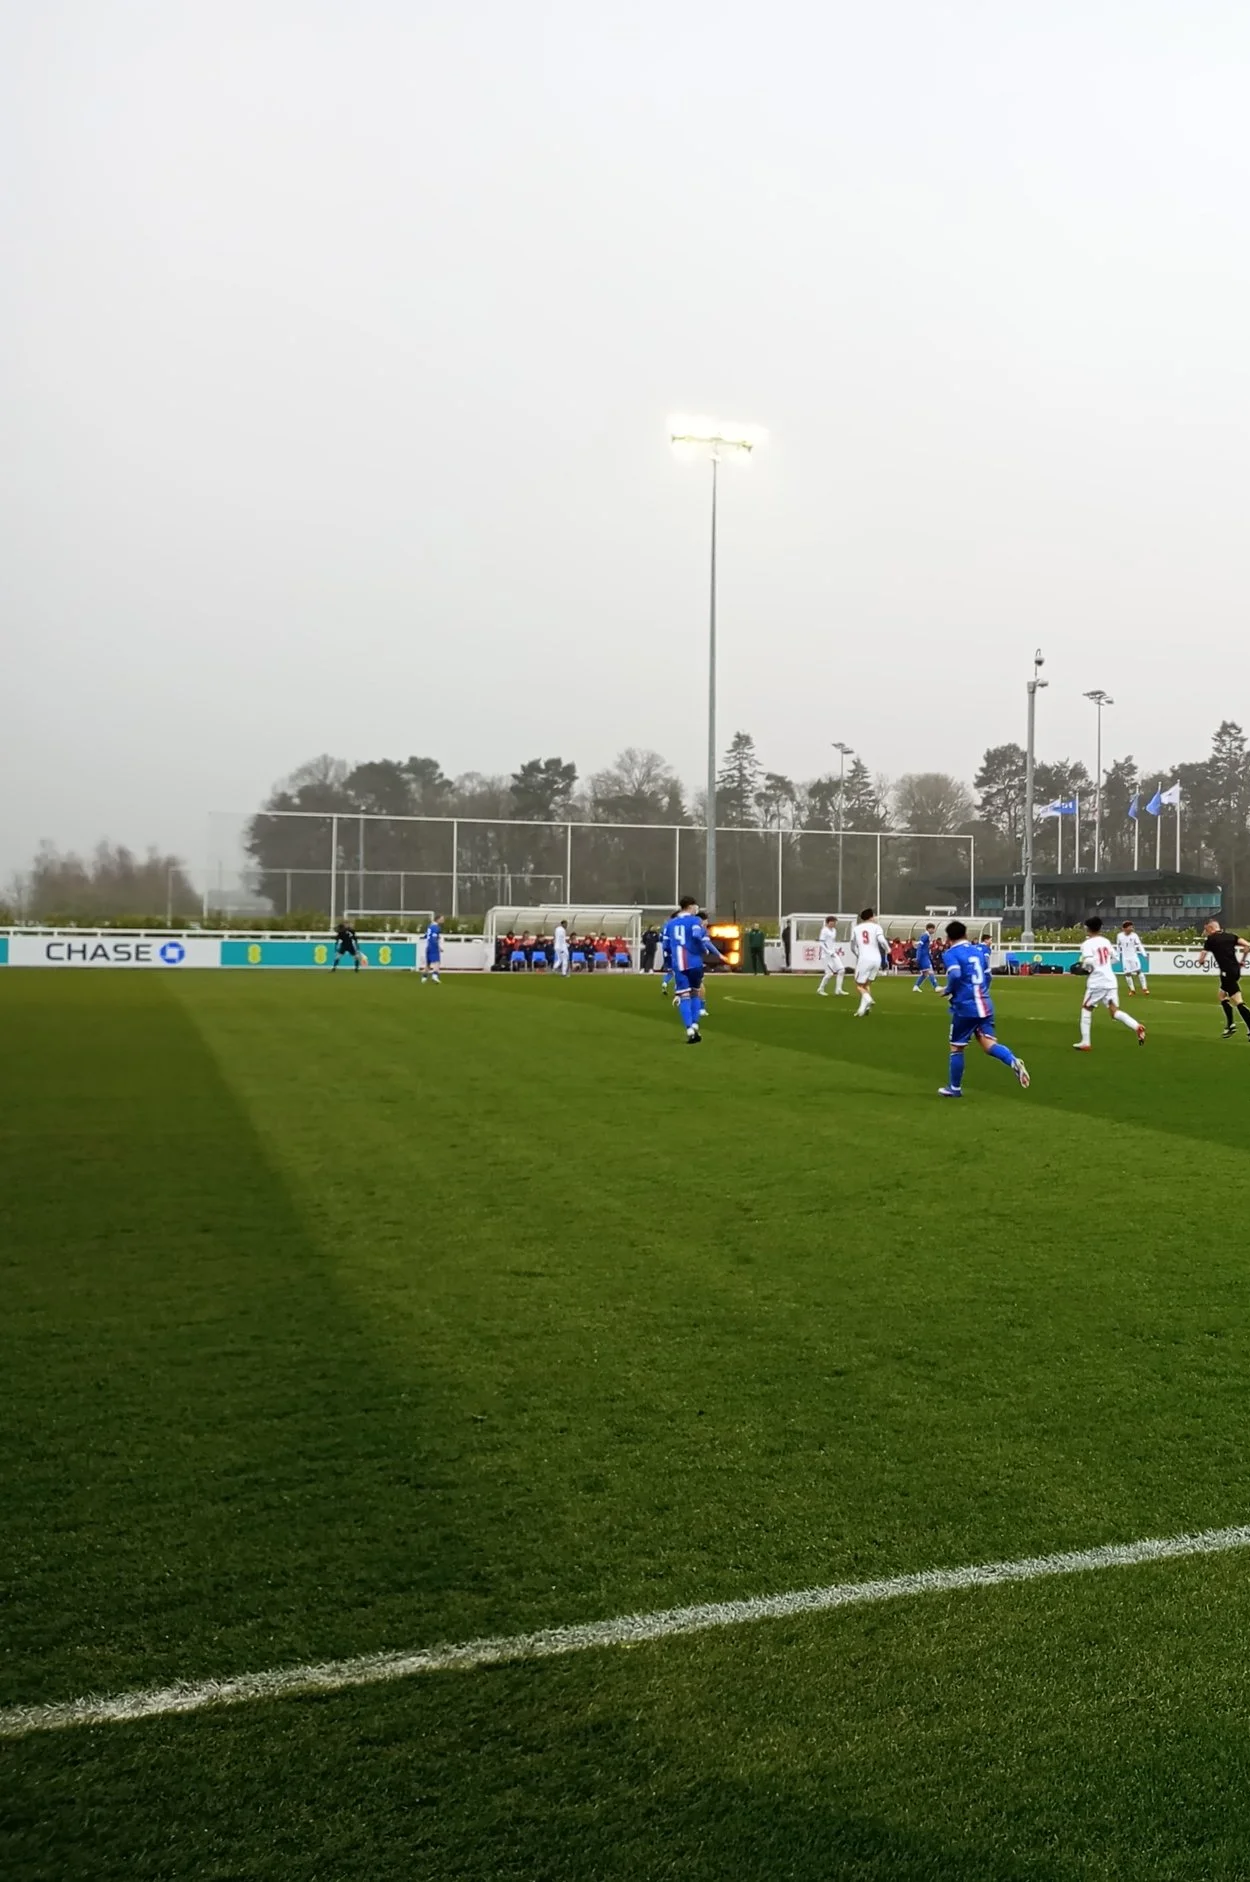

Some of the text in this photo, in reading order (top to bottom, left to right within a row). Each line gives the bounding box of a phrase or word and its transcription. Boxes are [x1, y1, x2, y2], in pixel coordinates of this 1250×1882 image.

[674, 924, 686, 945] 4
[46, 942, 153, 962] CHASE
[968, 956, 984, 984] 3
